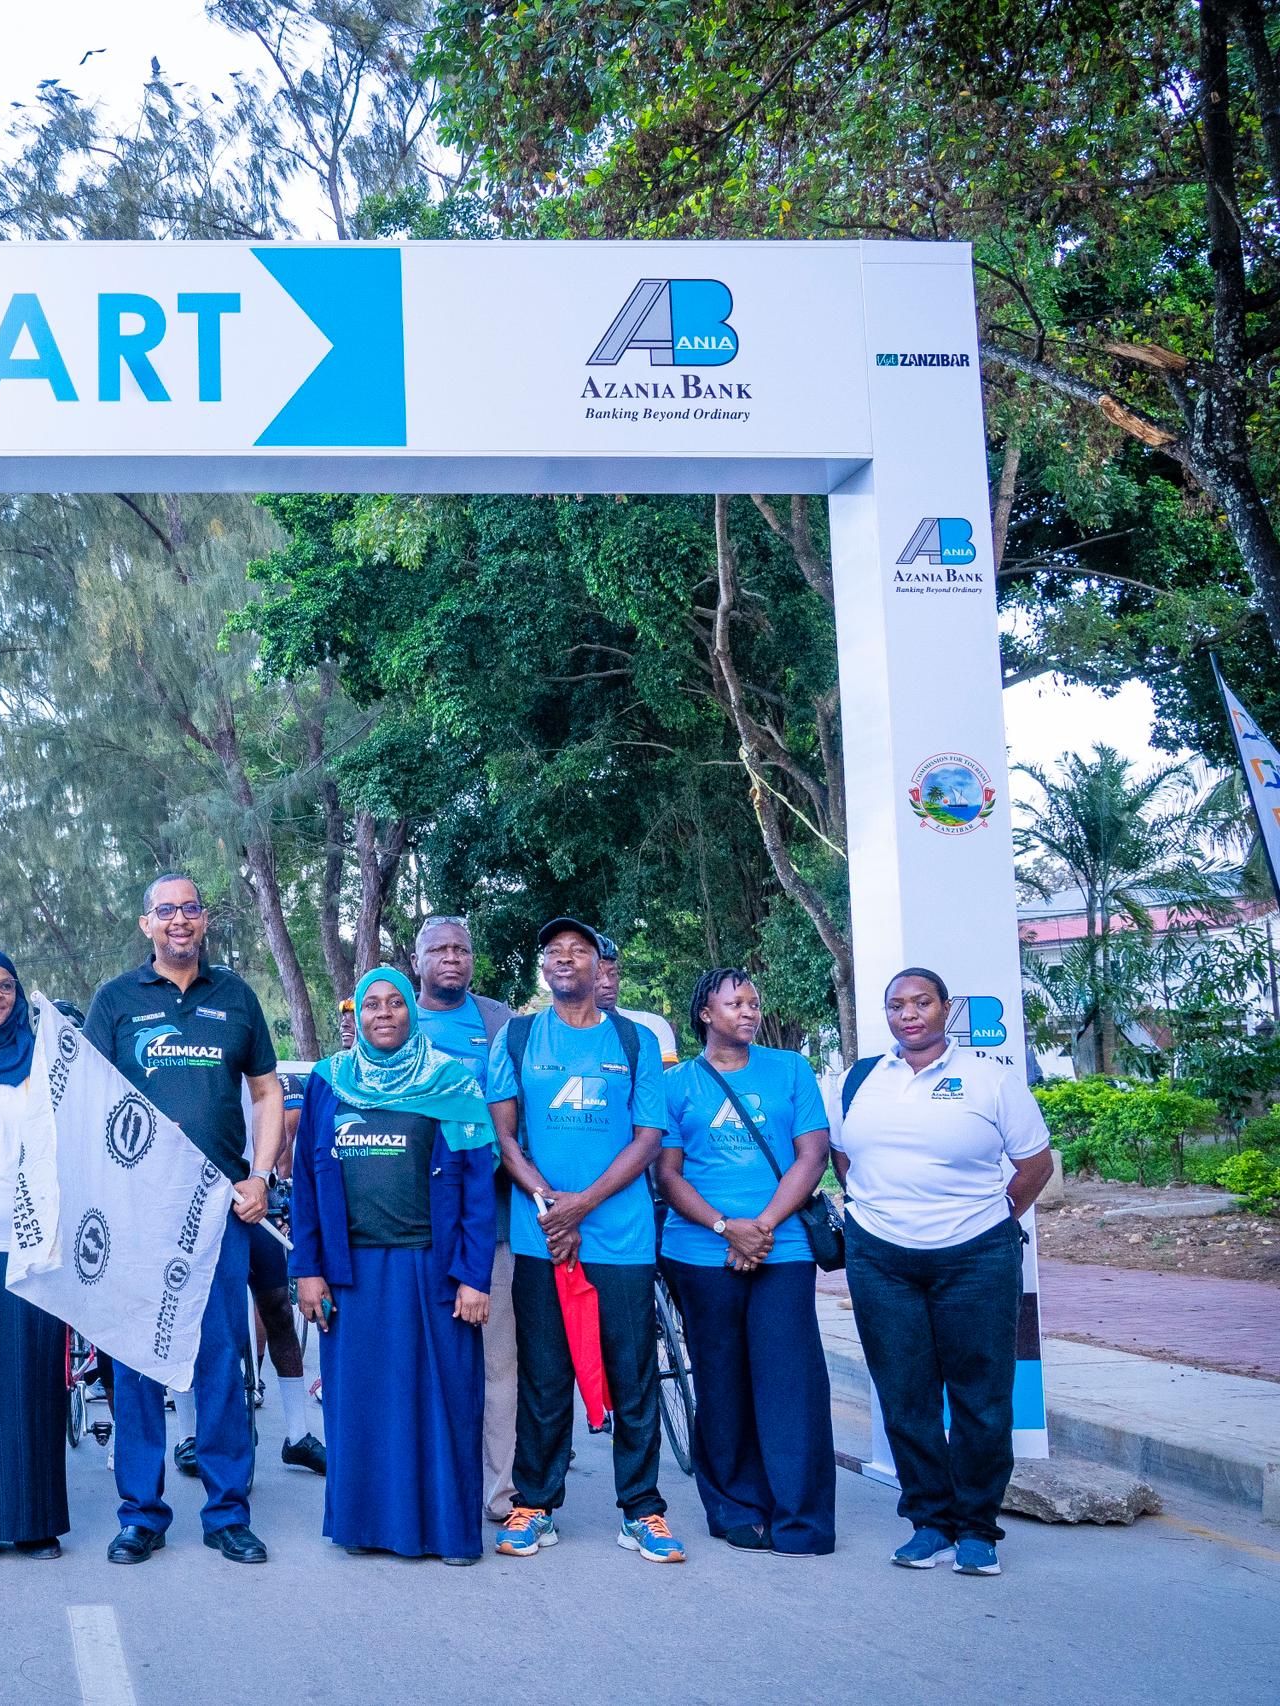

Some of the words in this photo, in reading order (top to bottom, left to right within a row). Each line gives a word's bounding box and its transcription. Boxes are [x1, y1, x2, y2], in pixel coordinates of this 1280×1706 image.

[676, 336, 734, 350] ANIA
[900, 353, 970, 367] ZANZIBAR
[680, 374, 753, 400] BANK
[585, 408, 639, 423] Banking
[642, 408, 690, 423] Beyond
[693, 408, 751, 423] Ordinary
[942, 547, 974, 556] ANIA
[945, 569, 984, 583] BANK
[895, 586, 925, 595] Banking
[926, 586, 951, 595] Beyond
[952, 586, 983, 595] Ordinary
[915, 756, 948, 782] COMMISSION
[964, 759, 988, 782] TOURISM
[935, 823, 974, 833] ZANZIBAR
[972, 1029, 1005, 1037] ANIA
[147, 1045, 223, 1059] KIZIMKAZI
[147, 1056, 187, 1067] Festival
[334, 1134, 407, 1147] KIZIMKAZI
[338, 1146, 369, 1157] estival
[18, 1172, 35, 1216] CHAMA
[31, 1218, 44, 1245] CHA
